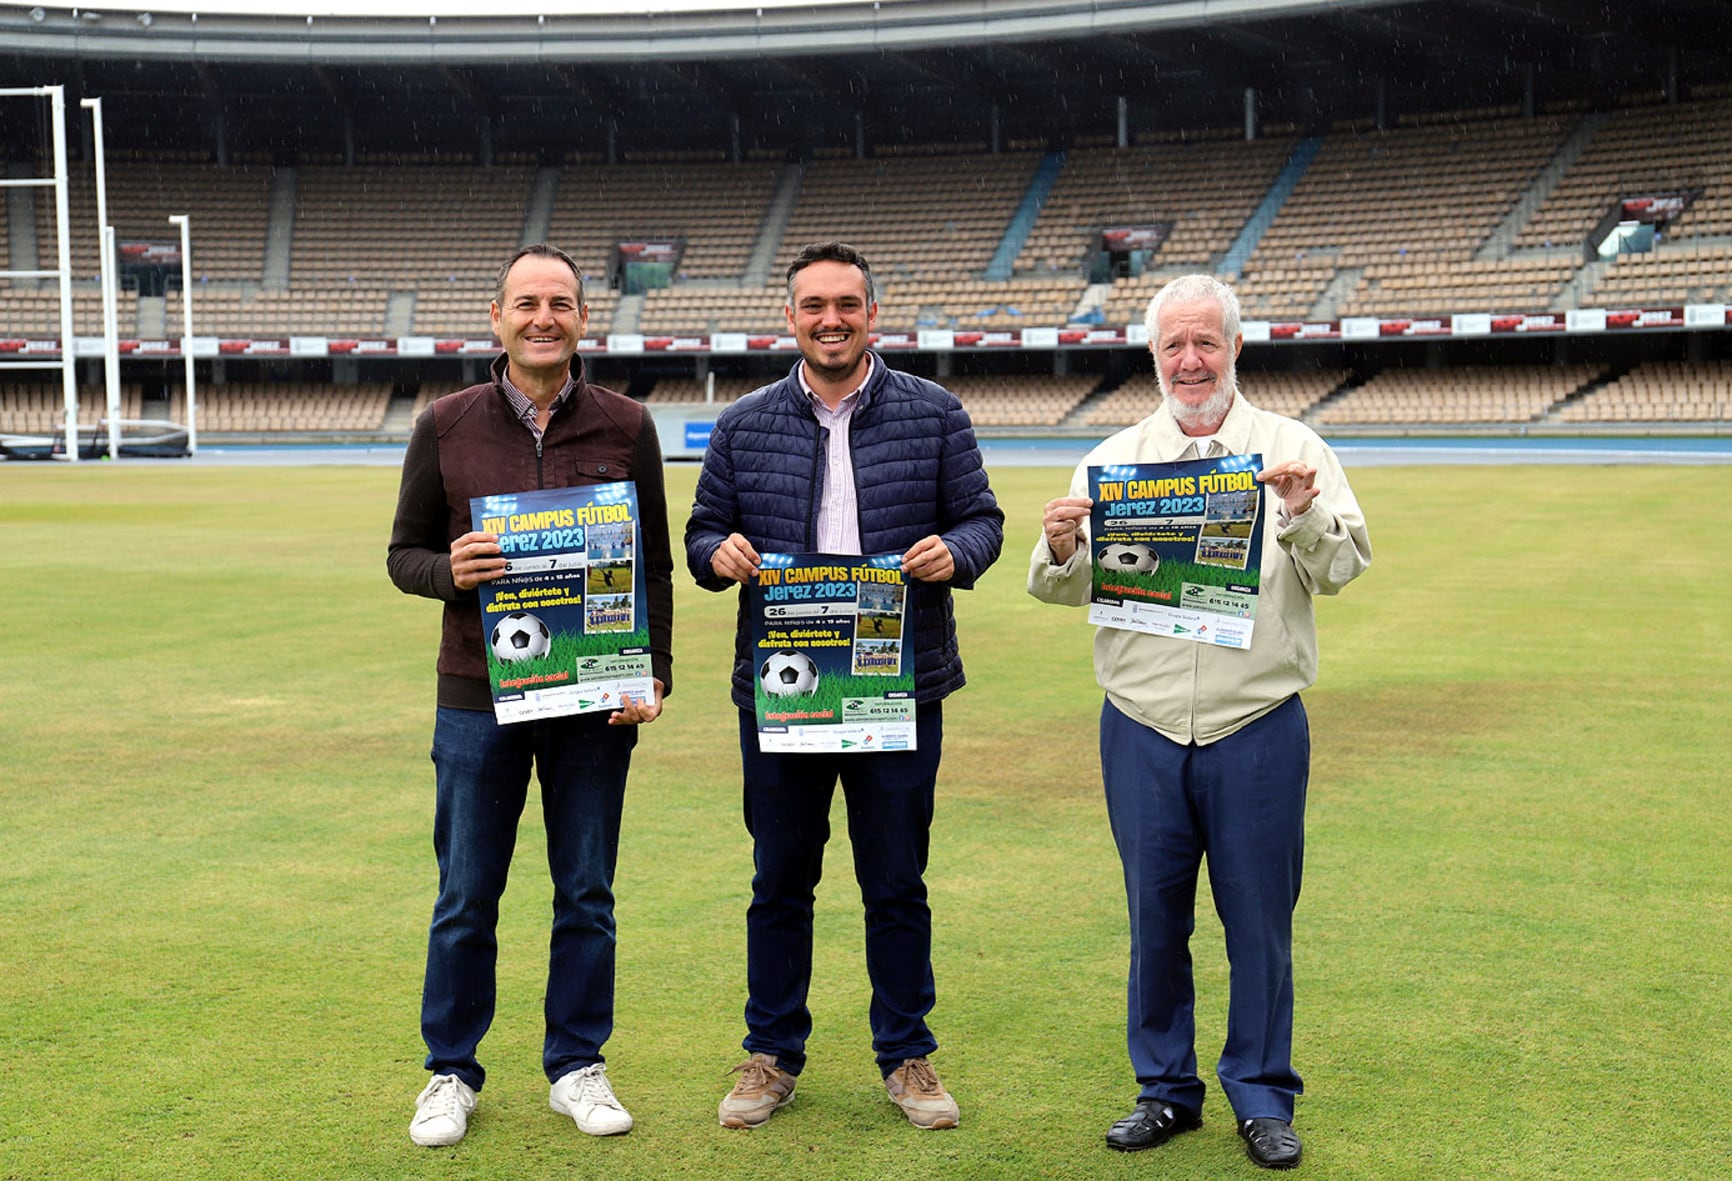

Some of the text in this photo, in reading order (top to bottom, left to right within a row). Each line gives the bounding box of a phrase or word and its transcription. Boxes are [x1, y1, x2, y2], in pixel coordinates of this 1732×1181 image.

[1099, 470, 1257, 501] XIV CAMPUS FÚTBOL
[1105, 497, 1204, 516] Jerez 2023
[482, 502, 632, 535] XIV CAMPUS FÚTBOL
[498, 528, 584, 554] erez 2023
[504, 561, 513, 572] 6
[549, 560, 557, 569] 7
[758, 564, 904, 586] XIV CAMPUS FÚTBOL
[564, 587, 570, 597] y
[764, 583, 856, 601] Jerez 2023
[486, 595, 581, 612] disfruta con nosotros!
[769, 608, 786, 616] 26
[821, 606, 829, 614] 7
[758, 639, 792, 648] disfruta
[811, 638, 850, 647] nosotros!
